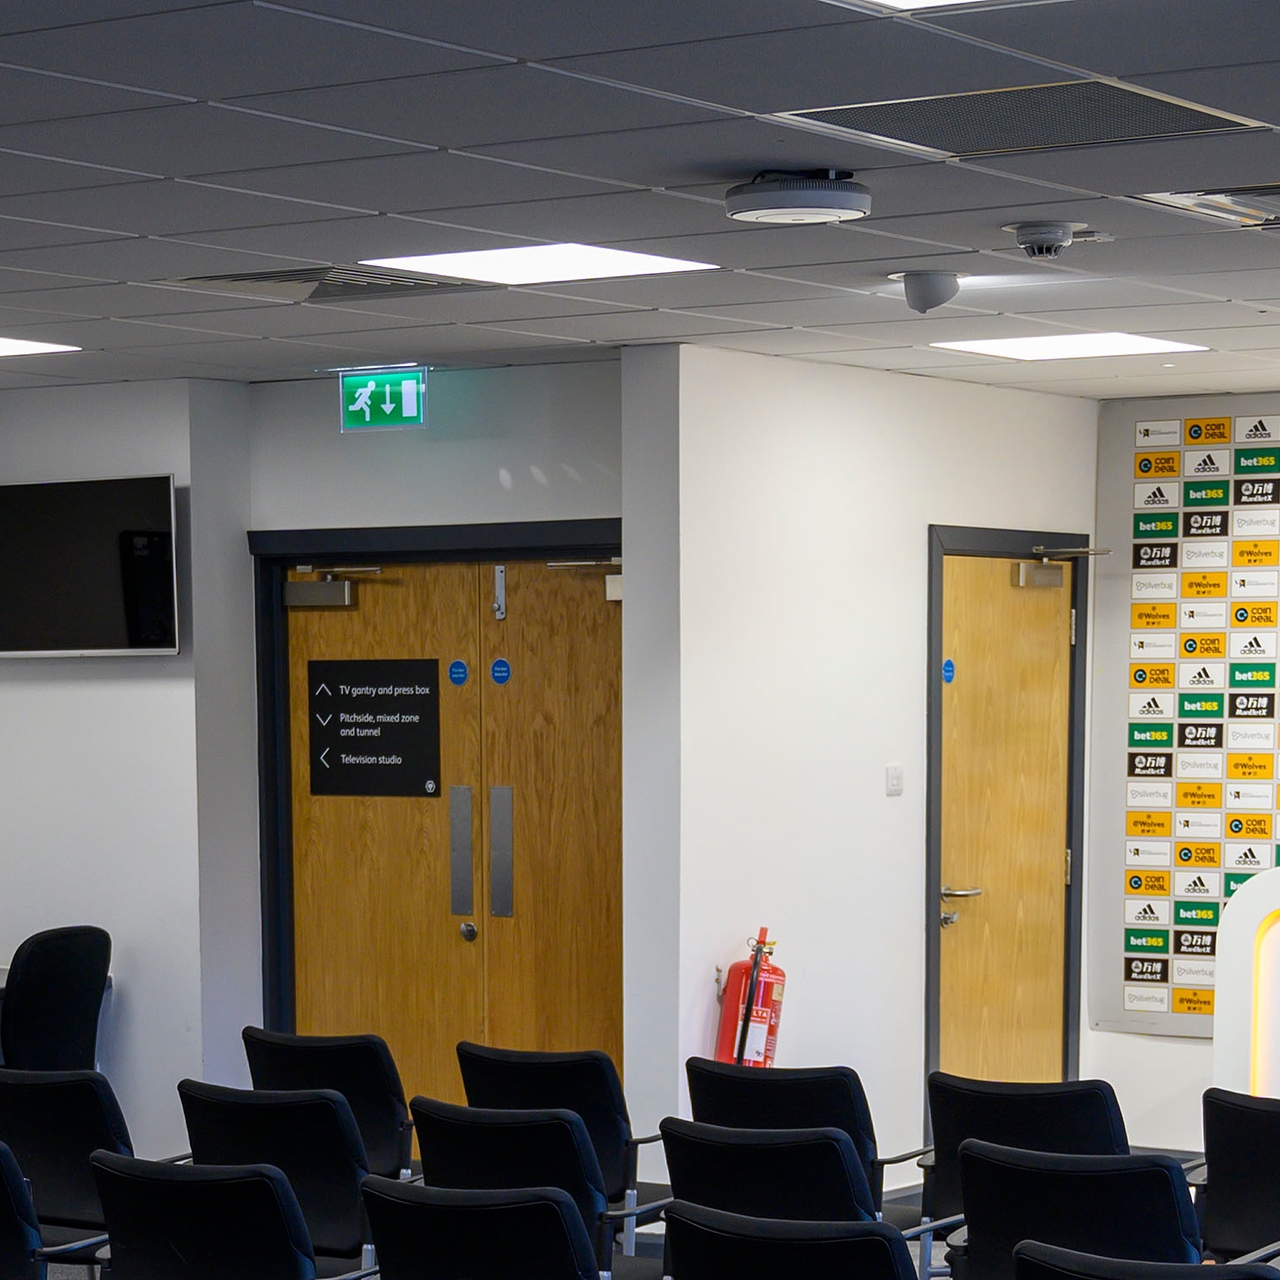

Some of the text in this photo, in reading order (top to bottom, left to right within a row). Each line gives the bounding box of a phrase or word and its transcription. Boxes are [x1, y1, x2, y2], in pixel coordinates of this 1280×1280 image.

[1244, 431, 1272, 440] adidas
[1240, 455, 1276, 467] bet365
[1193, 465, 1220, 473] adidas
[1188, 488, 1224, 500] bet365
[1143, 497, 1169, 506] adidas
[1138, 521, 1173, 532] bet365
[1238, 549, 1273, 558] @Wolves
[1187, 581, 1221, 589] @Wolves
[1239, 647, 1266, 655] adidas
[1235, 670, 1270, 681] bet365
[1188, 678, 1215, 686] adidas
[339, 685, 430, 697] TV gantry and press box
[1184, 700, 1219, 711] bet365
[340, 712, 420, 723] Pitchside, mixed zone
[340, 727, 381, 736] and tunnel
[1134, 730, 1168, 741] bet365
[341, 754, 403, 764] Television studio
[1233, 762, 1267, 770] @Wolves
[1182, 791, 1216, 799] @Wolves
[1184, 887, 1210, 895] adidas
[1134, 915, 1160, 923] adidas
[1179, 909, 1214, 920] bet365
[1130, 936, 1164, 948] bet365
[1178, 1000, 1212, 1009] @Wolves
